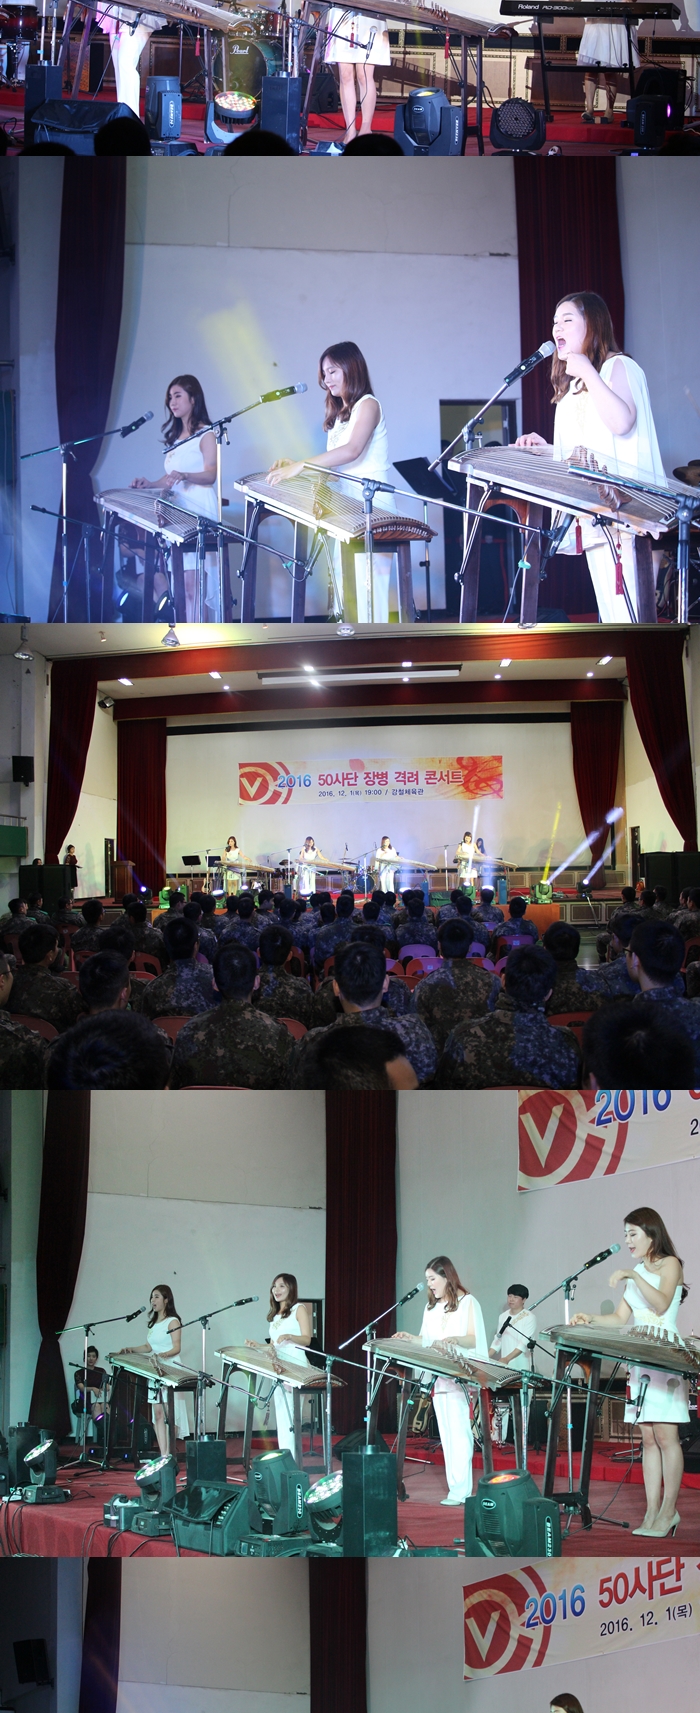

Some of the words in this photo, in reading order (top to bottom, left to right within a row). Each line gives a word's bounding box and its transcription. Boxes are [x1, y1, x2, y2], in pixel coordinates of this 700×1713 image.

[230, 45, 249, 54] Pearl
[278, 774, 311, 787] 2016
[318, 772, 358, 786] 50사단
[363, 771, 388, 786] 장병
[394, 770, 419, 785] 격려
[424, 770, 463, 784] 콘서트
[595, 1089, 671, 1126] 2016
[525, 1584, 586, 1629] 2016
[599, 1557, 685, 1608] 50사단
[600, 1618, 633, 1637] 2016.
[640, 1611, 658, 1627] 12.
[666, 1603, 692, 1621] 1(목)
